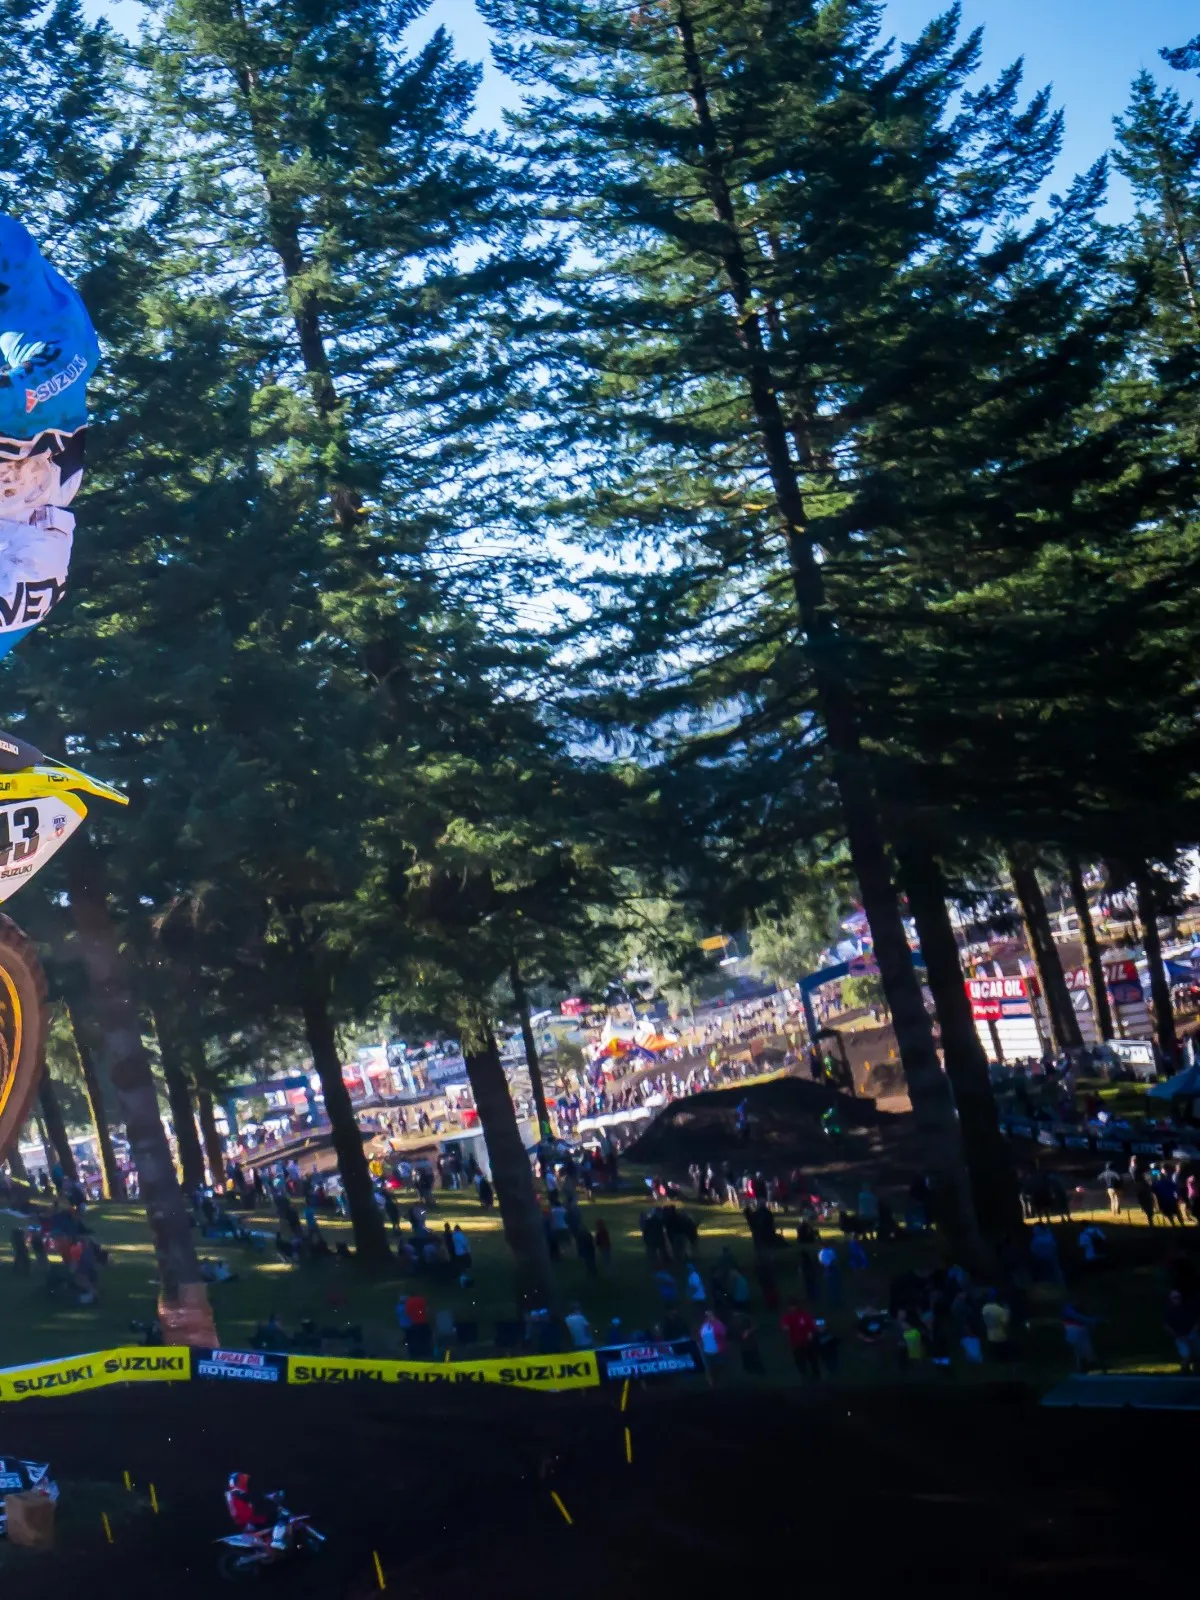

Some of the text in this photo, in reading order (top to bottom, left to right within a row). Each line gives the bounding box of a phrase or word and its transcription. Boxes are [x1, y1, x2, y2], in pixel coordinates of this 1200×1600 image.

[36, 353, 88, 402] SUZUK
[0, 864, 34, 879] SUZUKI
[970, 980, 1023, 999] LUCAS OIL
[13, 1365, 93, 1394] SUZUKI
[104, 1356, 184, 1373] SUZUKI
[294, 1366, 383, 1383] SUZUKI
[500, 1361, 590, 1383] SUZUKI
